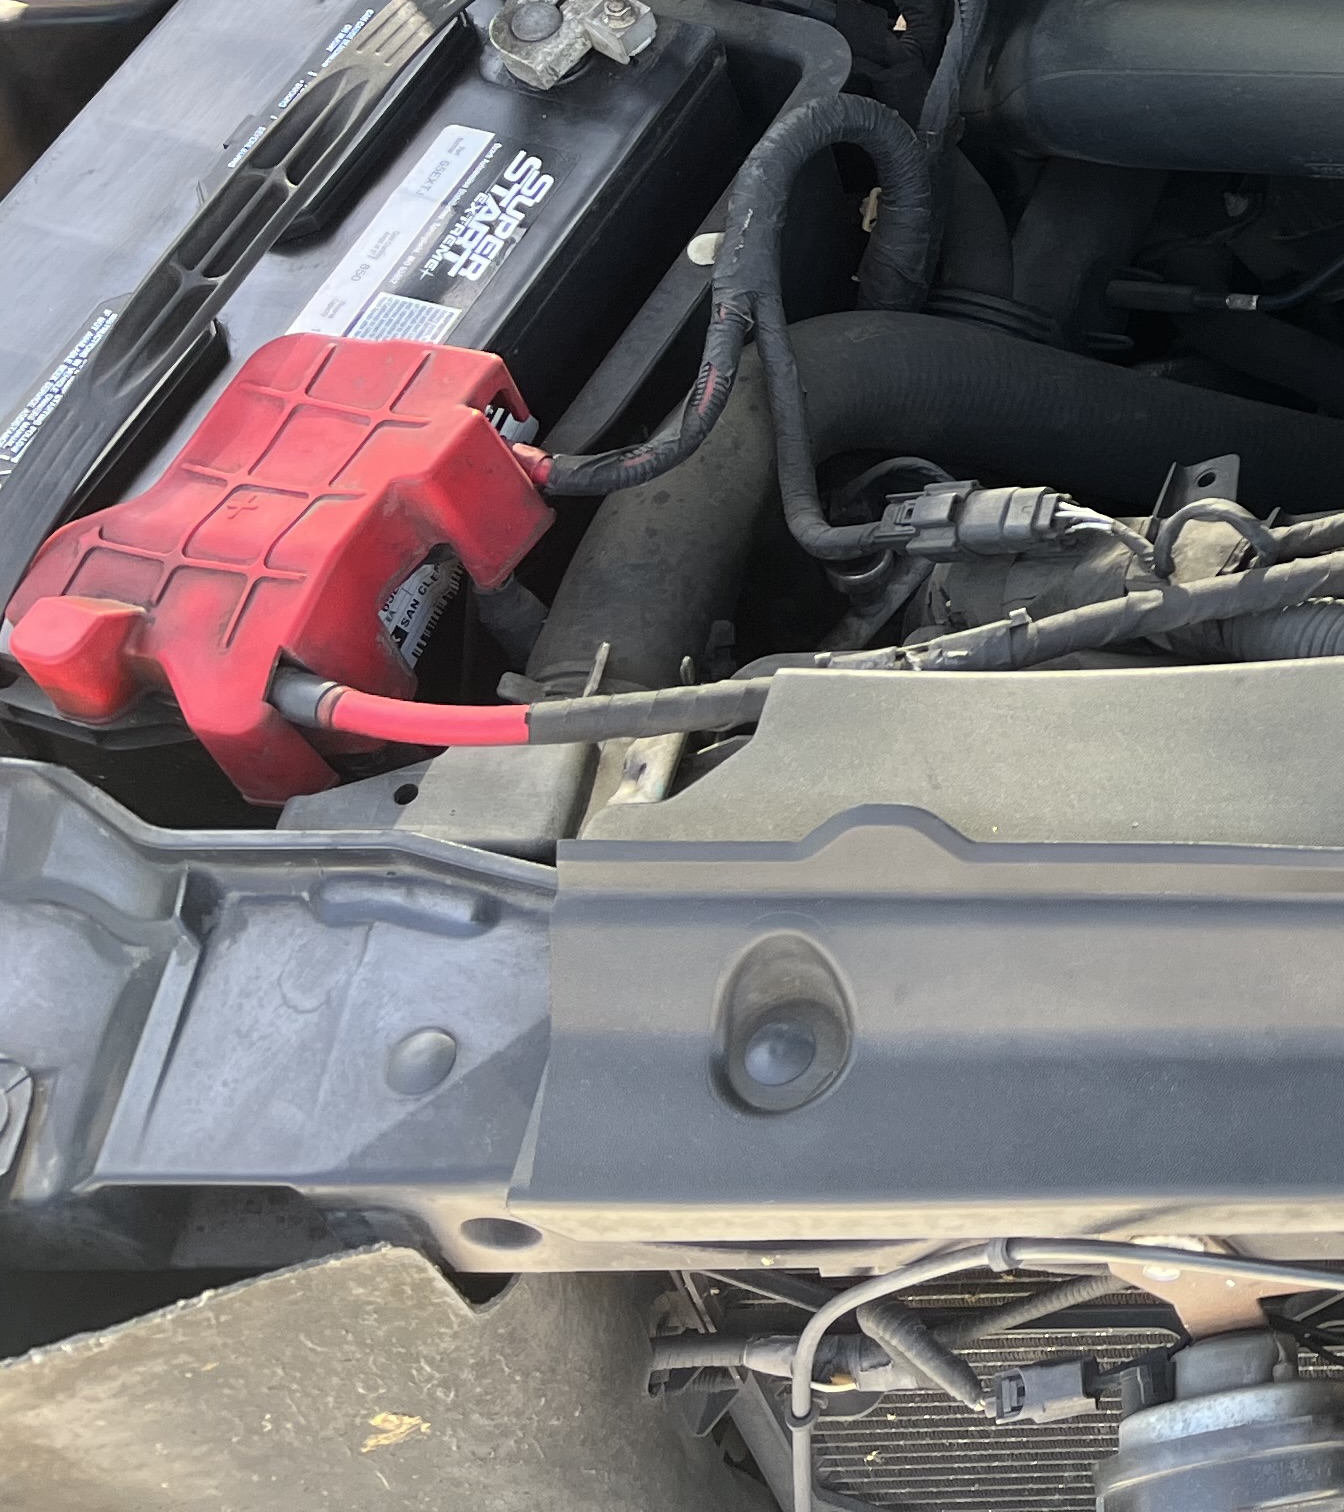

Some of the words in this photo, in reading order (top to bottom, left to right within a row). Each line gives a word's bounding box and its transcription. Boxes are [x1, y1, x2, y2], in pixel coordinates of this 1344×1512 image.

[419, 192, 487, 281] EXTREME+
[448, 150, 542, 277] START
[457, 170, 555, 281] SUPER
[400, 598, 420, 628] SAN
